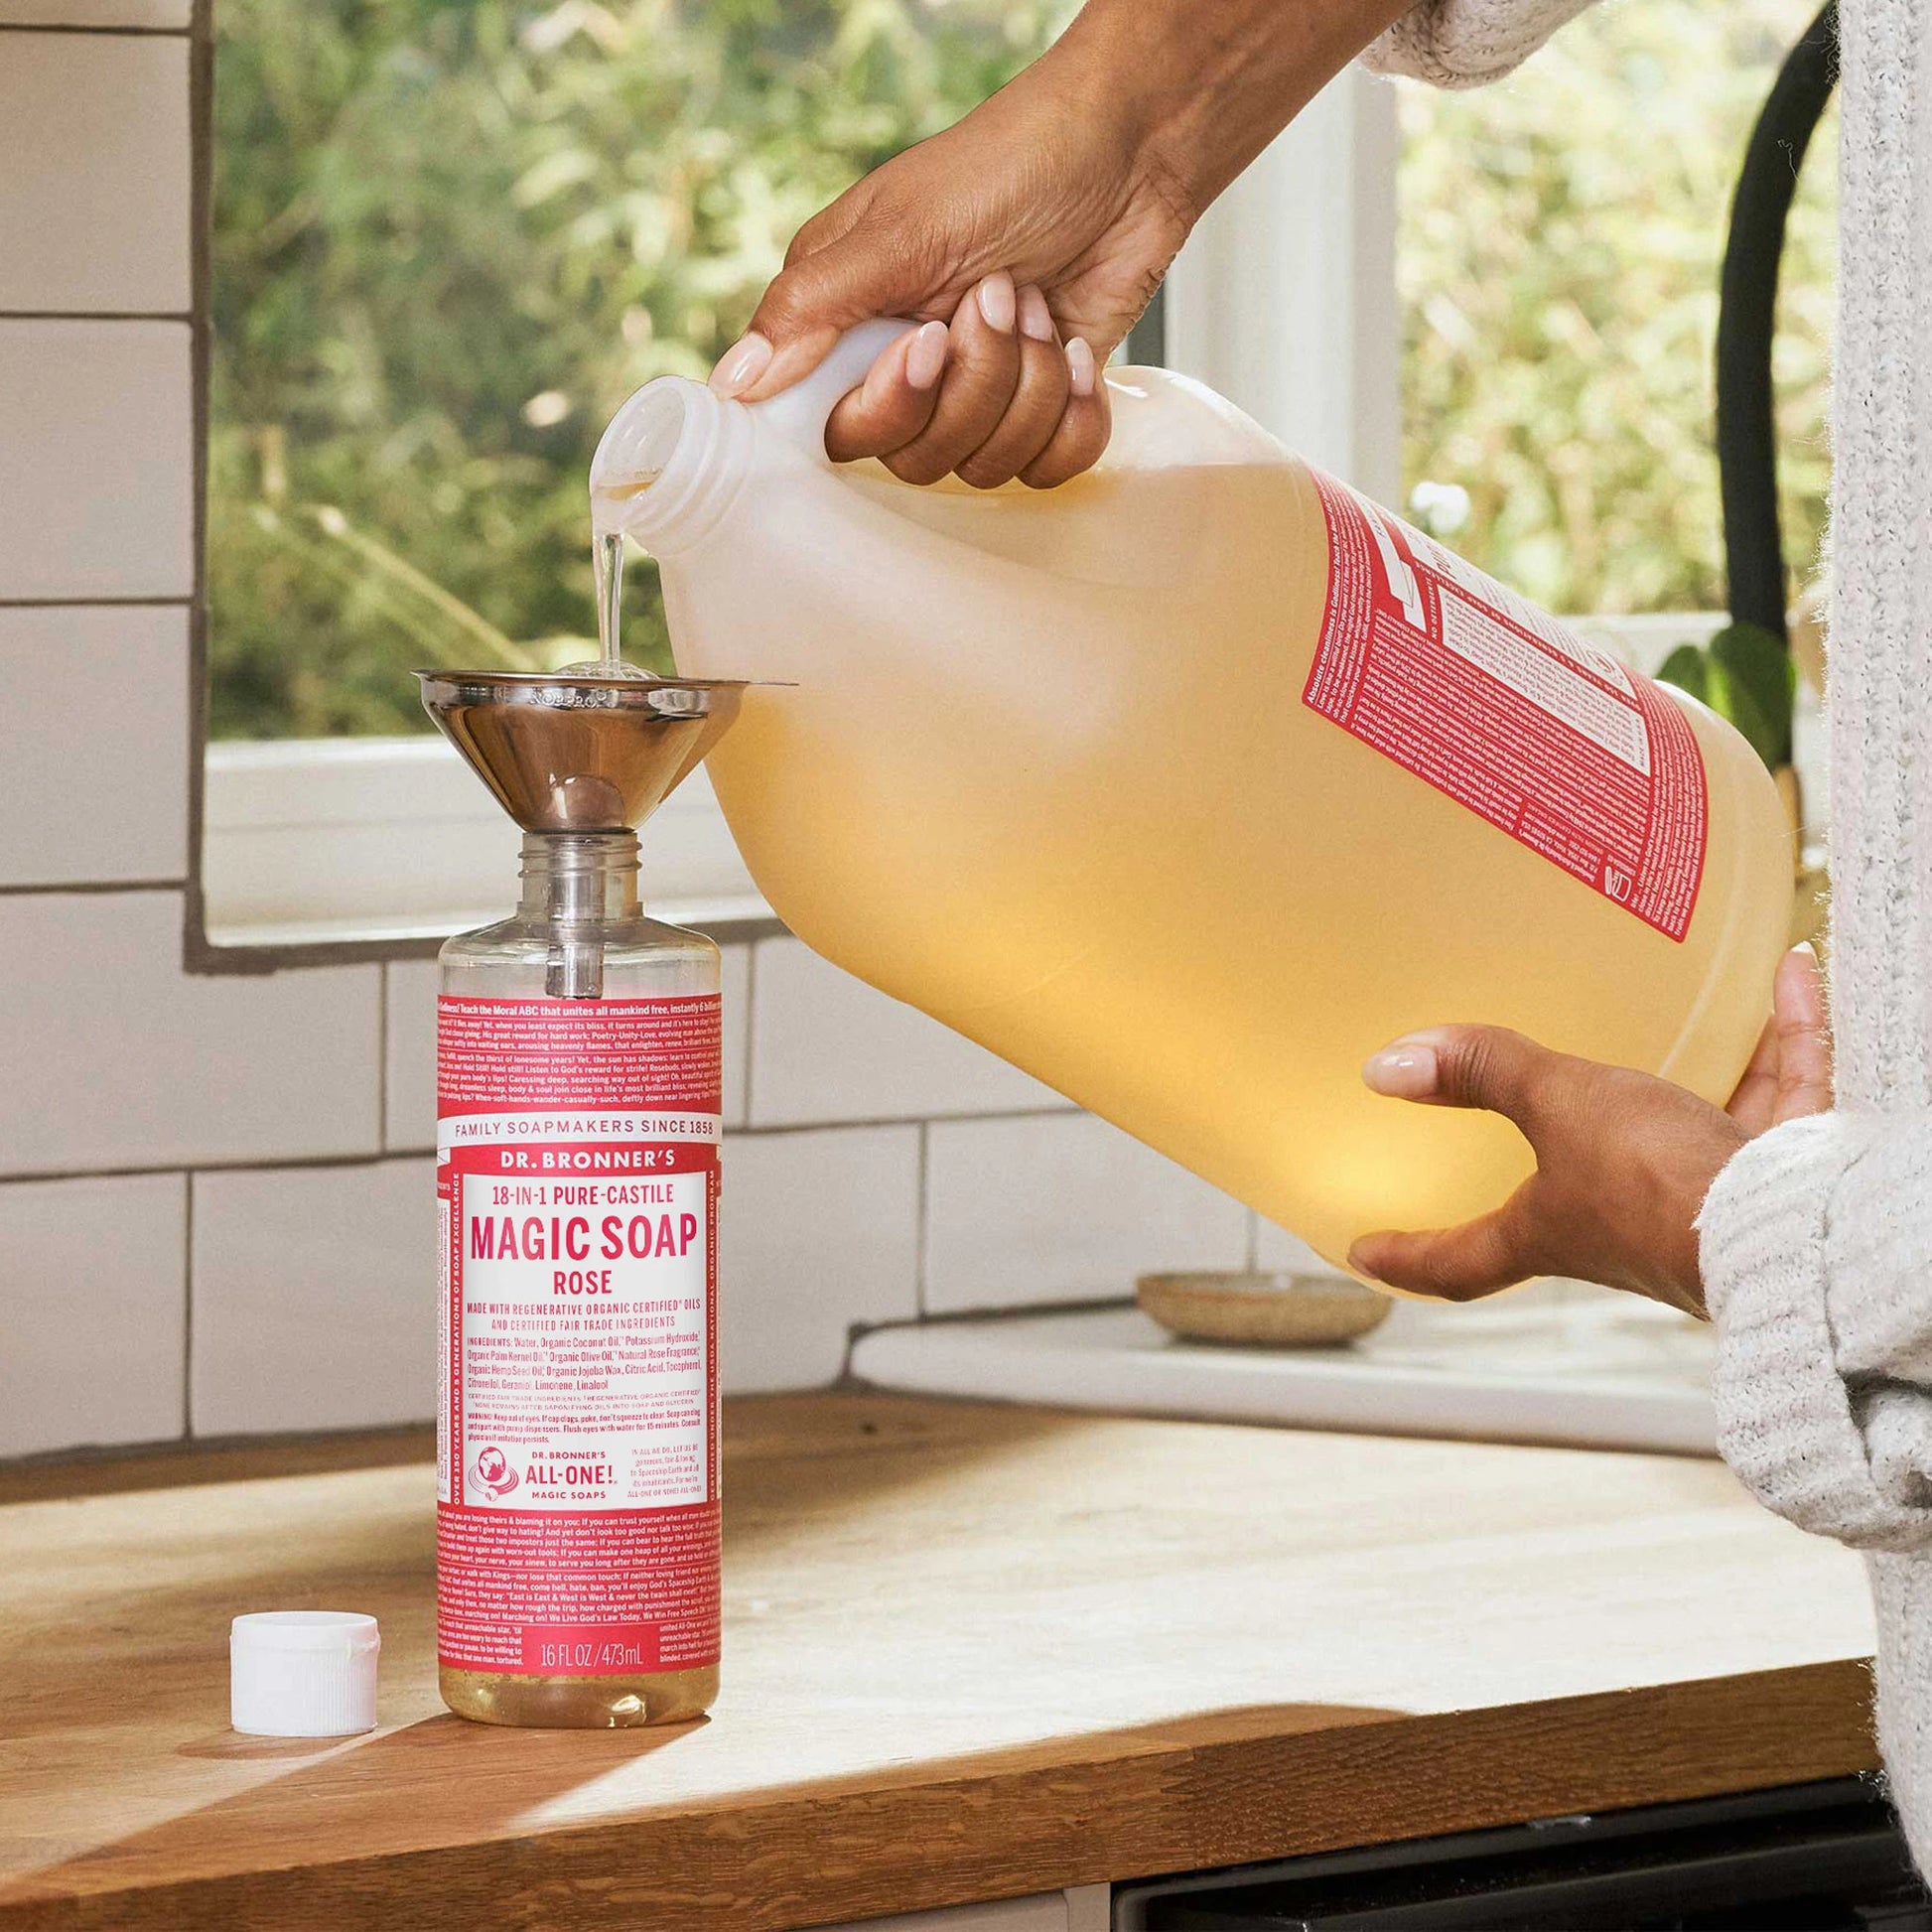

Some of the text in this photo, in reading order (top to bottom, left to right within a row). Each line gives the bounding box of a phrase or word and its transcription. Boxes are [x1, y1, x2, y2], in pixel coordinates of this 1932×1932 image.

[1308, 665, 1323, 703] Absolute
[1319, 619, 1335, 663] cleanliness
[493, 1006, 517, 1016] Moral
[519, 1006, 539, 1016] ABC
[541, 1006, 561, 1016] that
[563, 1006, 594, 1016] unites
[596, 1006, 608, 1016] all
[610, 1005, 649, 1016] mankind
[548, 1023, 573, 1032] expect
[455, 1120, 714, 1138] FAMILY SOAPMAKERS SINCE 1858
[501, 1150, 675, 1170] DR. BRONNER'S
[492, 1183, 674, 1205] 18-IN-1 PURE-CASTILE
[471, 1212, 697, 1261] MAGIC SOAP
[553, 1270, 613, 1296] ROSE
[468, 1303, 486, 1314] MADE
[489, 1304, 510, 1314] WITH
[512, 1305, 583, 1314] REGENERATIVE
[587, 1303, 629, 1314] ORGANIC
[684, 1299, 701, 1310] OILS
[491, 1316, 675, 1330] AND CERTIFIED FAIR TRADE INGREDIENTS
[541, 1337, 572, 1349] Organic
[573, 1337, 607, 1348] Coconut
[490, 1350, 507, 1361] Palm
[508, 1351, 532, 1362] Kernel
[550, 1352, 579, 1364] Organic
[581, 1351, 601, 1362] Olive
[619, 1350, 646, 1360] Natural
[492, 1365, 511, 1376] Hemp
[547, 1366, 577, 1377] Organic
[578, 1365, 604, 1378] Jojoba
[577, 1380, 608, 1390] Linalool
[525, 1465, 613, 1485] ALL-ONE!
[515, 1517, 544, 1527] blaming
[589, 1519, 603, 1528] you
[540, 1644, 556, 1667] 16
[558, 1644, 573, 1667] FL
